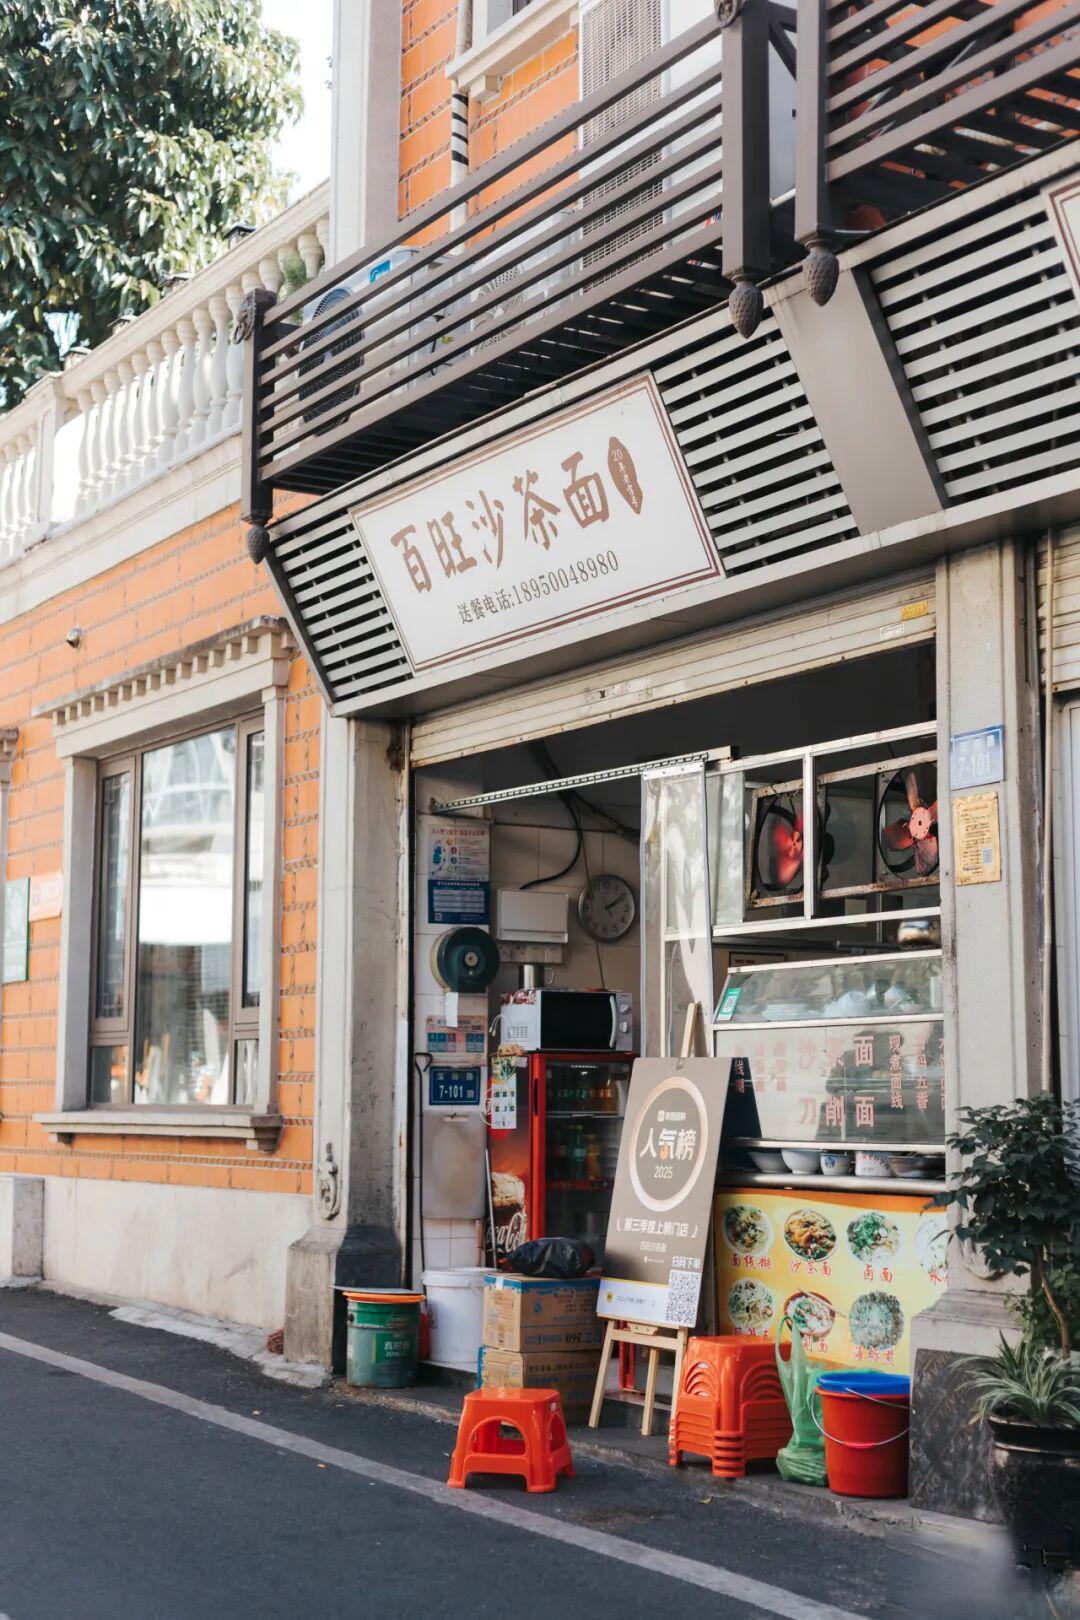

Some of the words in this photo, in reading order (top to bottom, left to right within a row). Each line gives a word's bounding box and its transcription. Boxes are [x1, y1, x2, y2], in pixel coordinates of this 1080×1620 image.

[391, 451, 609, 593] 百旺沙茶面
[456, 549, 619, 625] 送餐电话:18950048980
[798, 1096, 875, 1128] 刀削面
[639, 1128, 697, 1161] 人气榜
[653, 1165, 674, 1180] 2025
[790, 1260, 832, 1277] 沙茶面
